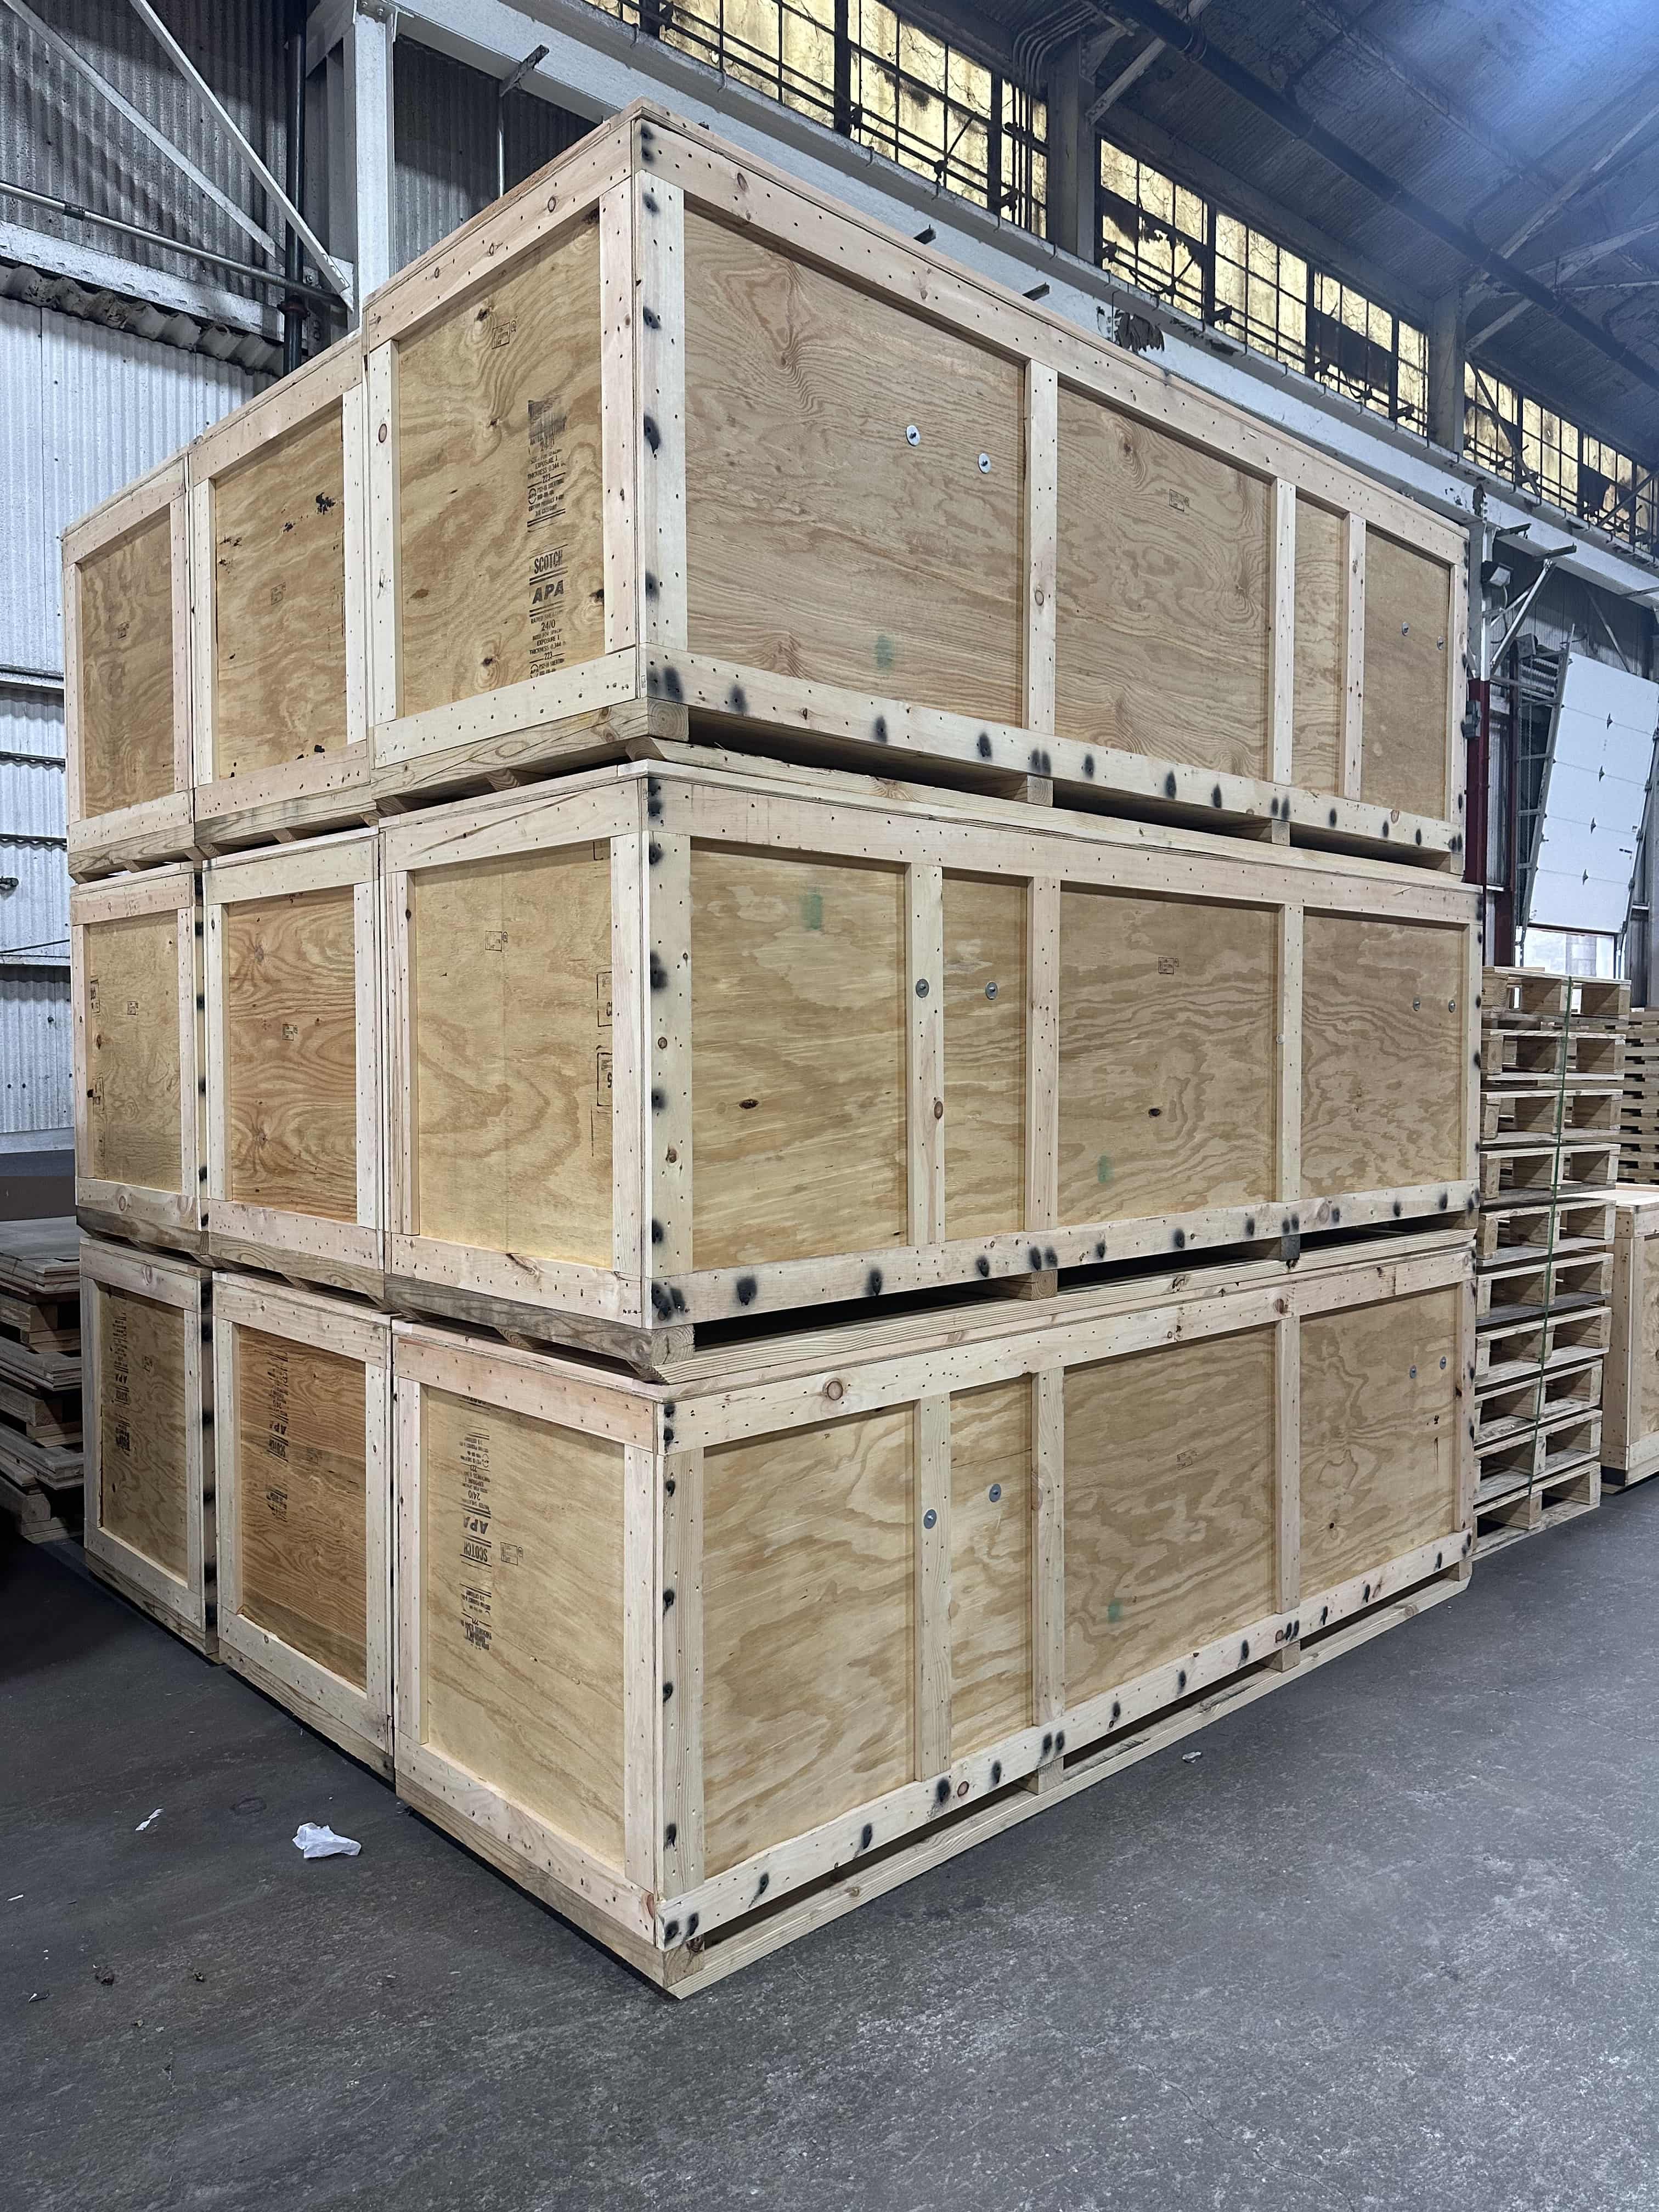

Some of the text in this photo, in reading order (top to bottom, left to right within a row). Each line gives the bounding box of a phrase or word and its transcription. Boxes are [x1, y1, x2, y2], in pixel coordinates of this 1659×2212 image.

[542, 473, 551, 483] 223
[534, 550, 563, 574] SCOTCH
[532, 579, 564, 604] APA
[541, 619, 555, 631] 24/0
[537, 635, 556, 646] EXPOSURE
[529, 646, 549, 654] THICKNESS
[544, 651, 552, 660] 223
[469, 1490, 481, 1500] 24/0
[464, 1516, 488, 1534] APA
[464, 1541, 488, 1562] SCOTCH
